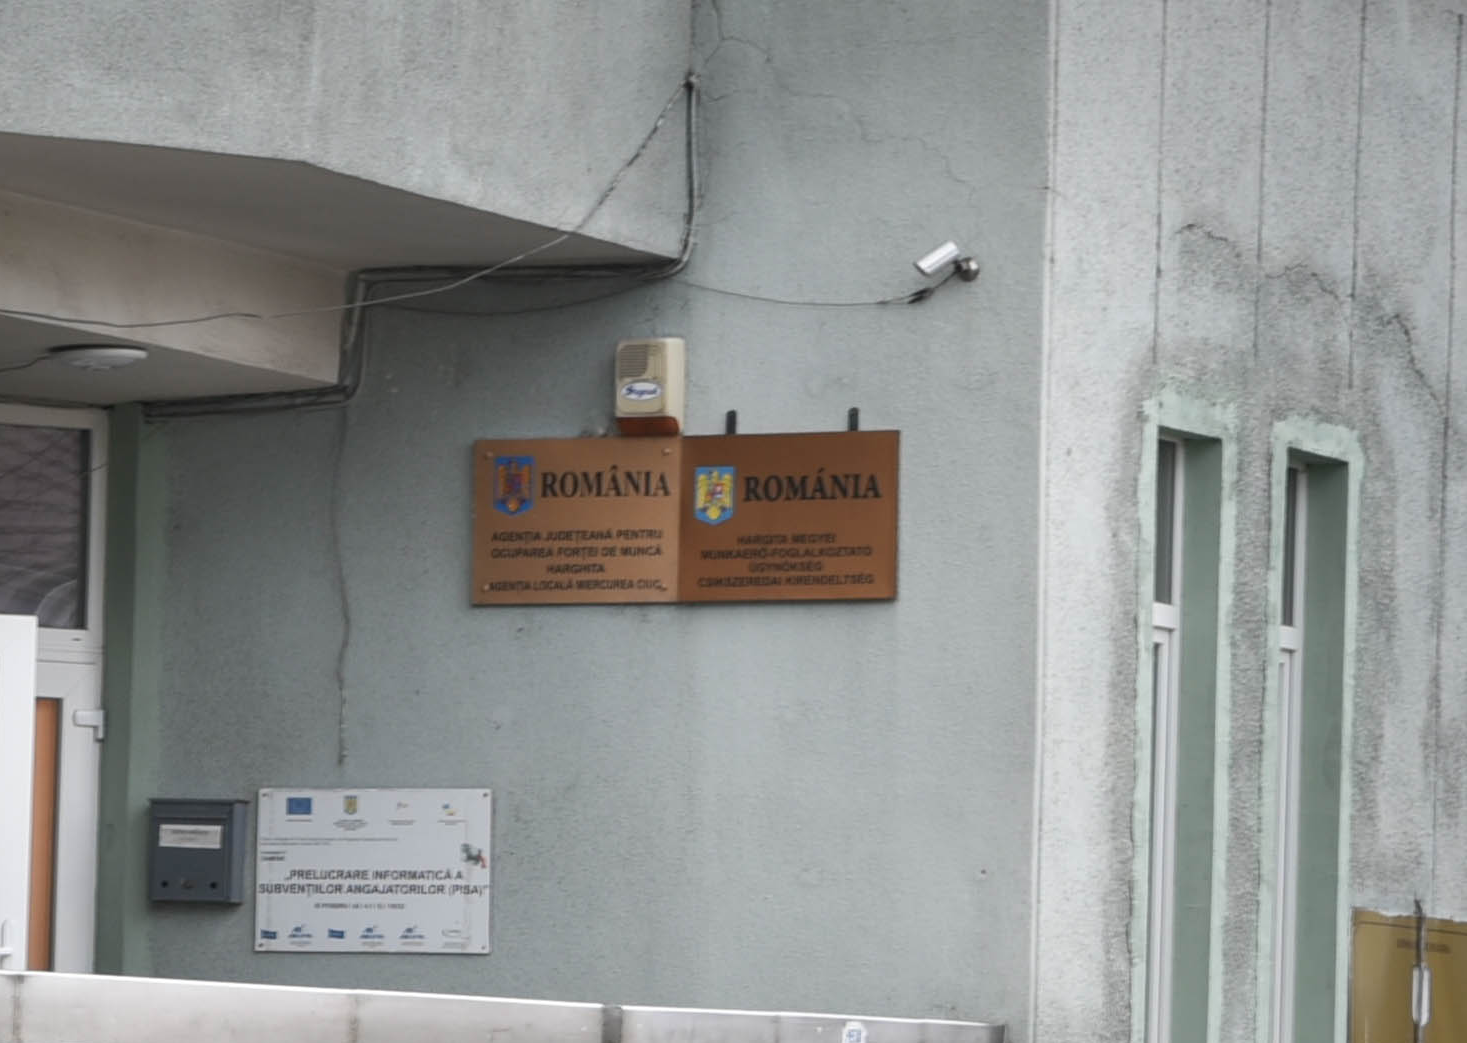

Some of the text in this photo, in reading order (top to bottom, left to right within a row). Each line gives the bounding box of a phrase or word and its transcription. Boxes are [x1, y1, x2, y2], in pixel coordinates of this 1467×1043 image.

[541, 465, 671, 498] ROMÂNIA
[743, 468, 882, 503] ROMÁNIA
[616, 529, 663, 542] PENTRU
[601, 546, 618, 558] DE
[546, 563, 606, 575] HARGHITA
[453, 871, 464, 881] A
[346, 884, 445, 896] ANGAJATORILOR
